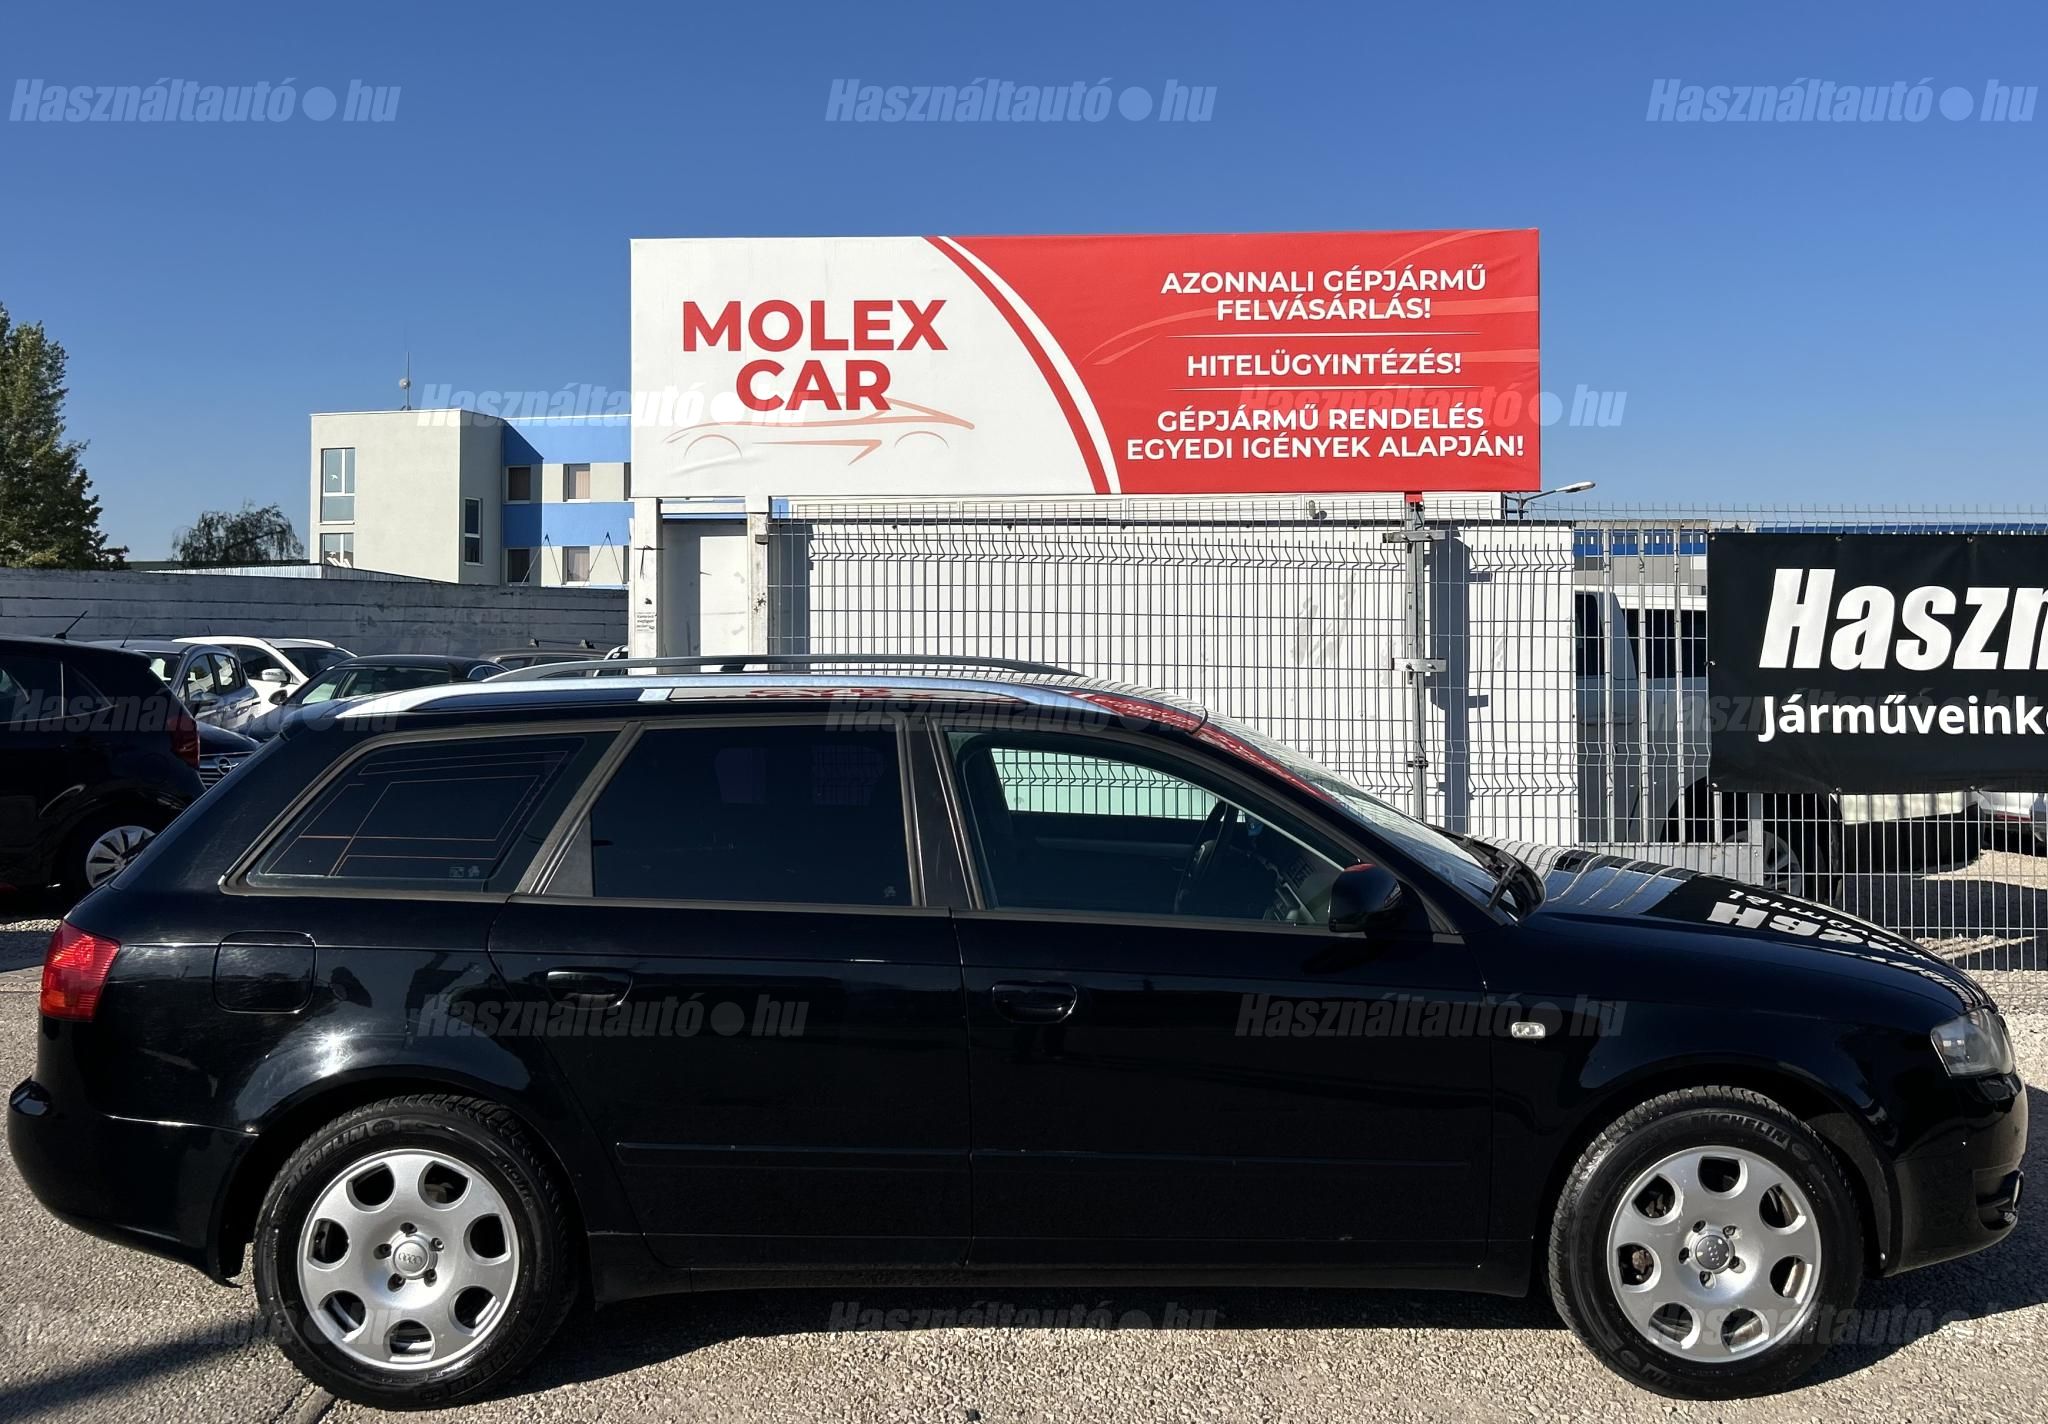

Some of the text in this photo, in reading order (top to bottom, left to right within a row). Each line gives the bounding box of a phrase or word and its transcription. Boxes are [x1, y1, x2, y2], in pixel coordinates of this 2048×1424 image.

[1161, 265, 1487, 295] AZONNALI GÉPJÁRMŰ
[1217, 294, 1431, 321] FELVÁSÁRLÁS!
[683, 299, 948, 352] MOLEX
[1187, 348, 1462, 377] HITELÜGYINTÉZÉS!
[736, 359, 891, 411] CAR
[1157, 403, 1486, 432] GÉPJÁRMŰ RENDELÉS
[1127, 429, 1525, 460] EGYEDI IGÉNYEK ALAPJÁN!
[1758, 693, 2048, 743] Járműveink
